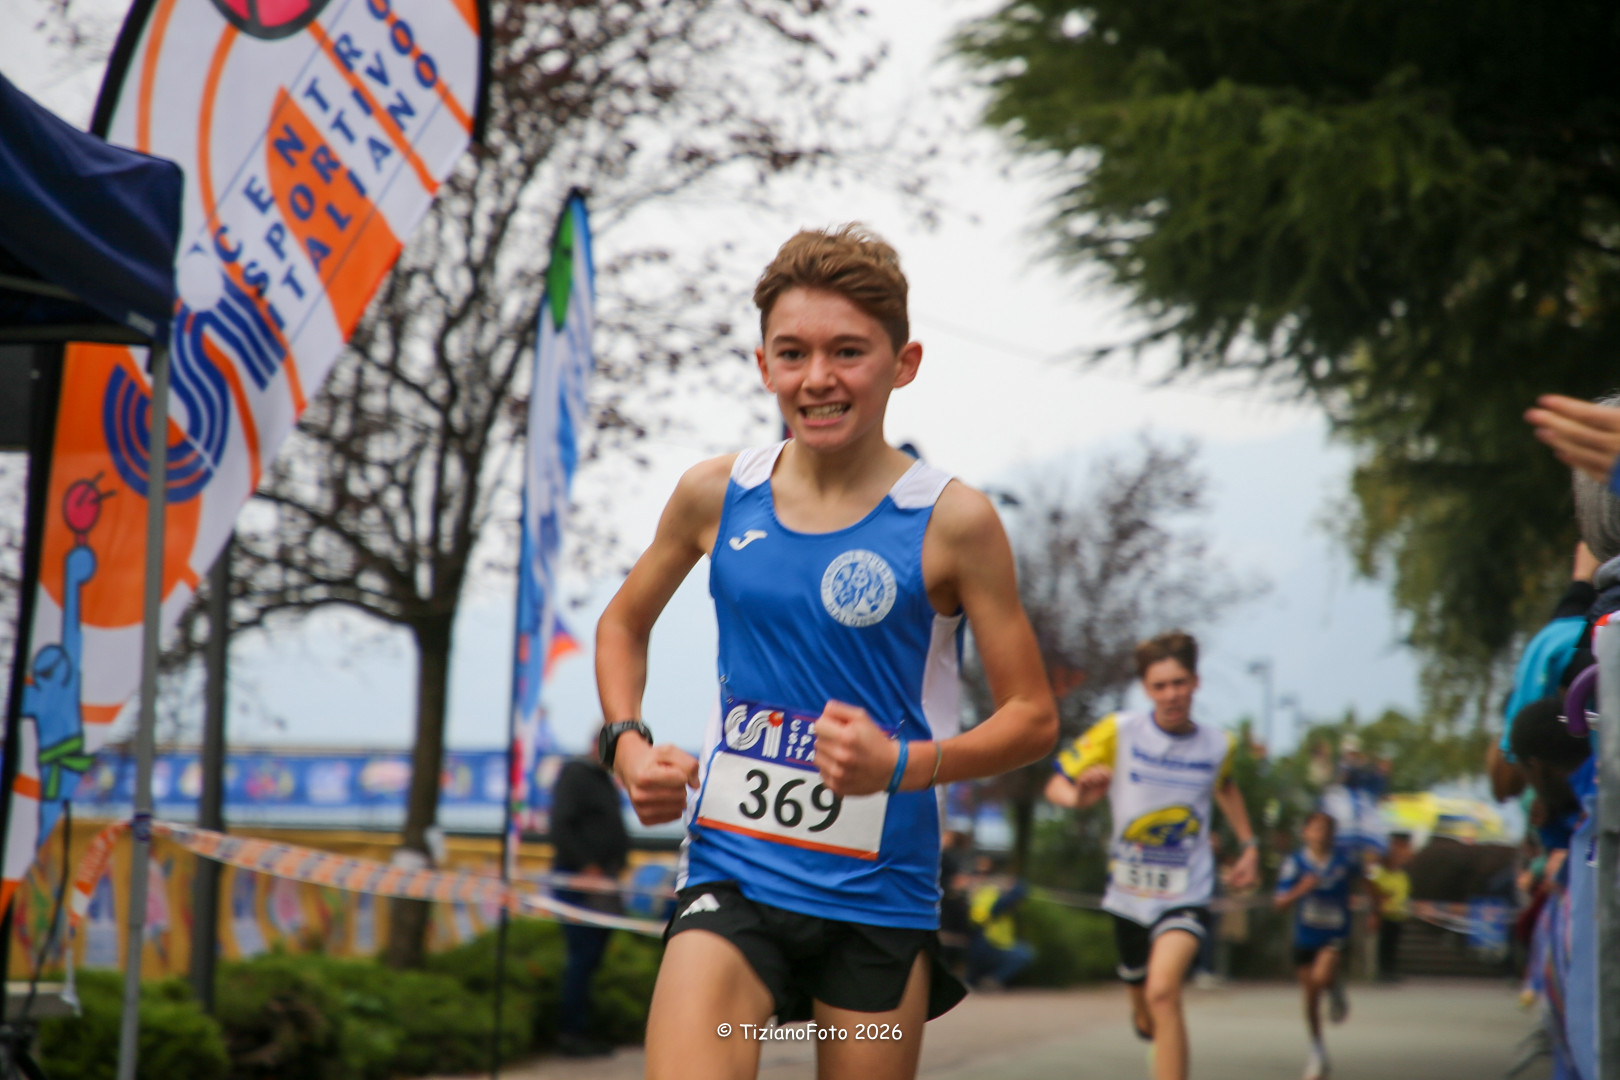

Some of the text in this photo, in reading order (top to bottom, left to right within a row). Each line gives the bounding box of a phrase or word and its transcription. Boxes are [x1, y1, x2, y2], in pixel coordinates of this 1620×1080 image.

[243, 19, 414, 296] SPORTIVO
[266, 52, 438, 330] ITALIANO
[738, 769, 843, 832] 369
